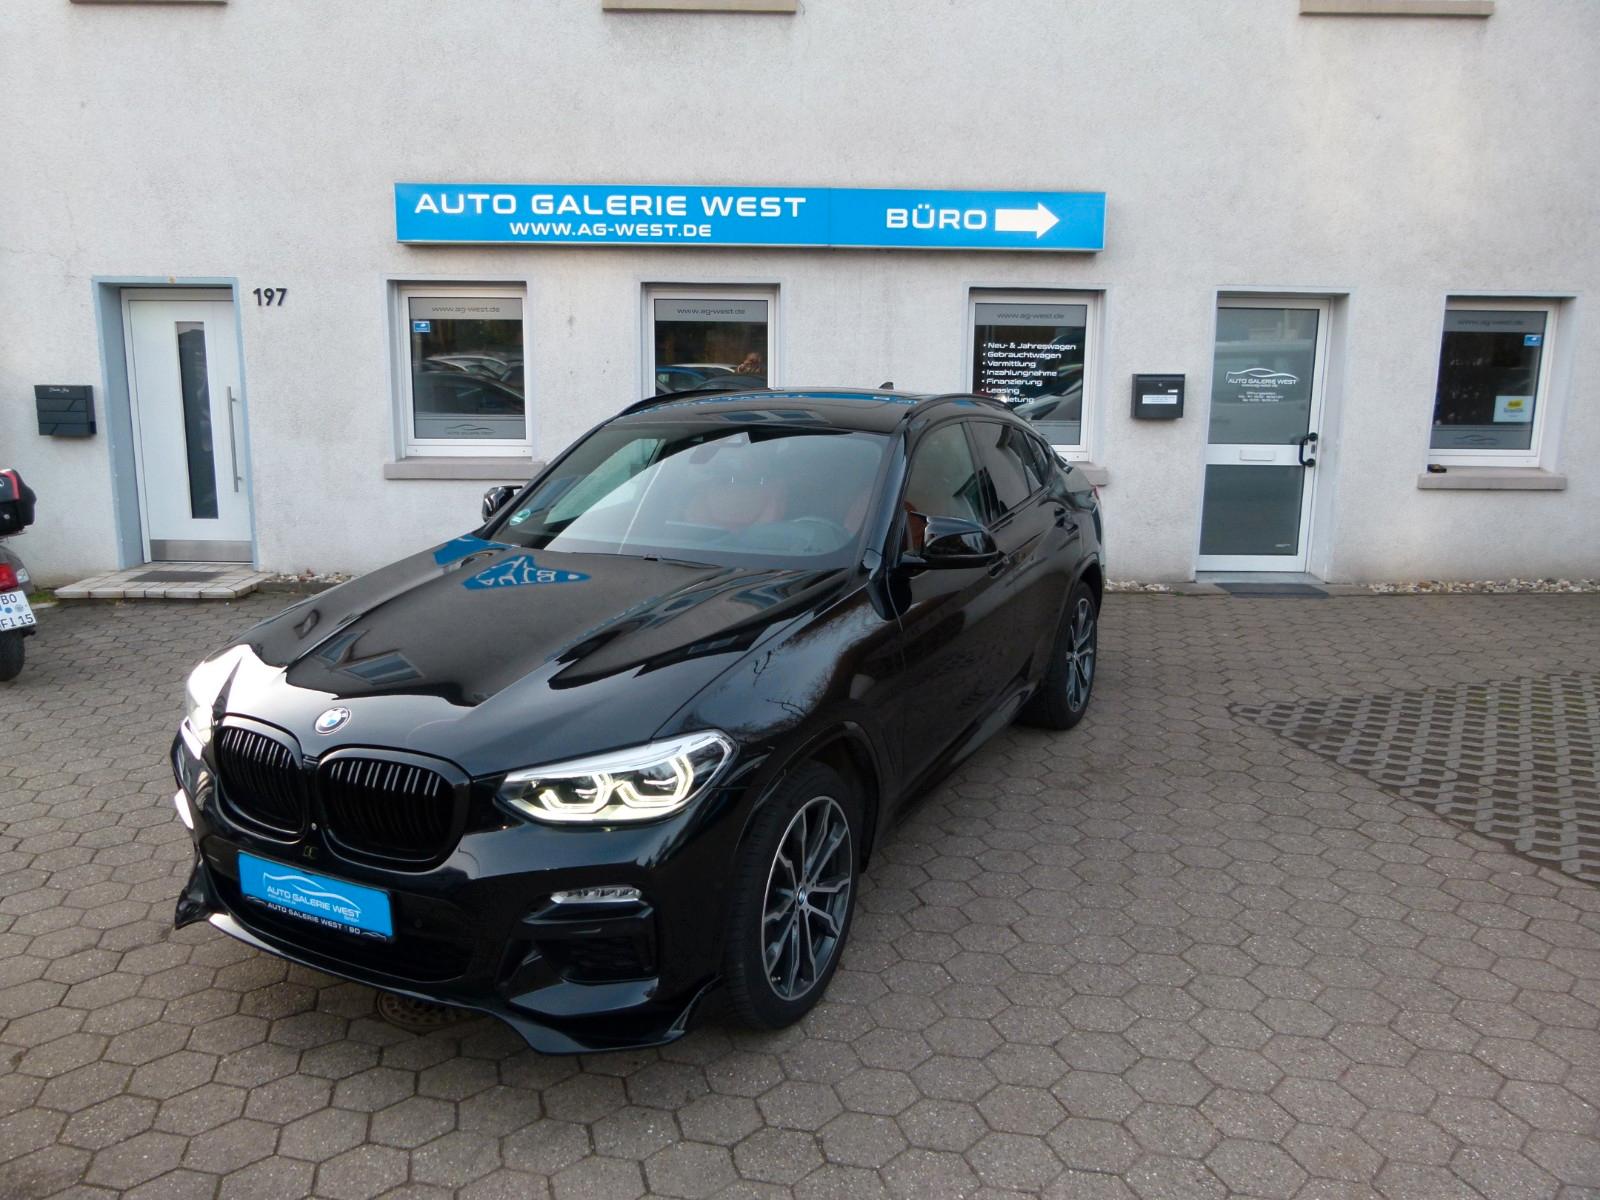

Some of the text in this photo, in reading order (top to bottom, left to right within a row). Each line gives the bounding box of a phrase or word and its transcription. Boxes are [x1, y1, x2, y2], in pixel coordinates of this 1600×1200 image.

[414, 193, 807, 218] AUTO GALERIE WEST
[886, 204, 987, 229] BÜRO
[509, 221, 712, 238] WWW.AG-WEST.DE
[253, 287, 288, 307] 197
[431, 305, 501, 314] www.ag-west.de
[676, 307, 746, 316] www.ag-west.de
[996, 312, 1065, 320] www.ag-west.de
[1017, 342, 1077, 351] Jahreswagen
[987, 351, 1062, 360] Gebrauchtwagen
[987, 360, 1037, 369] Vermittlung
[986, 369, 1058, 377] Inzahlungnahme
[986, 378, 1044, 387] Finanzierung
[986, 386, 1021, 395] Leasing
[0, 594, 17, 605] BO
[18, 613, 34, 625] 15
[266, 885, 292, 899] AUTO
[292, 892, 331, 910] GALERIE
[332, 904, 362, 919] WEST
[267, 902, 288, 913] AUTO
[288, 909, 320, 924] GALERIE
[320, 918, 343, 930] WEST
